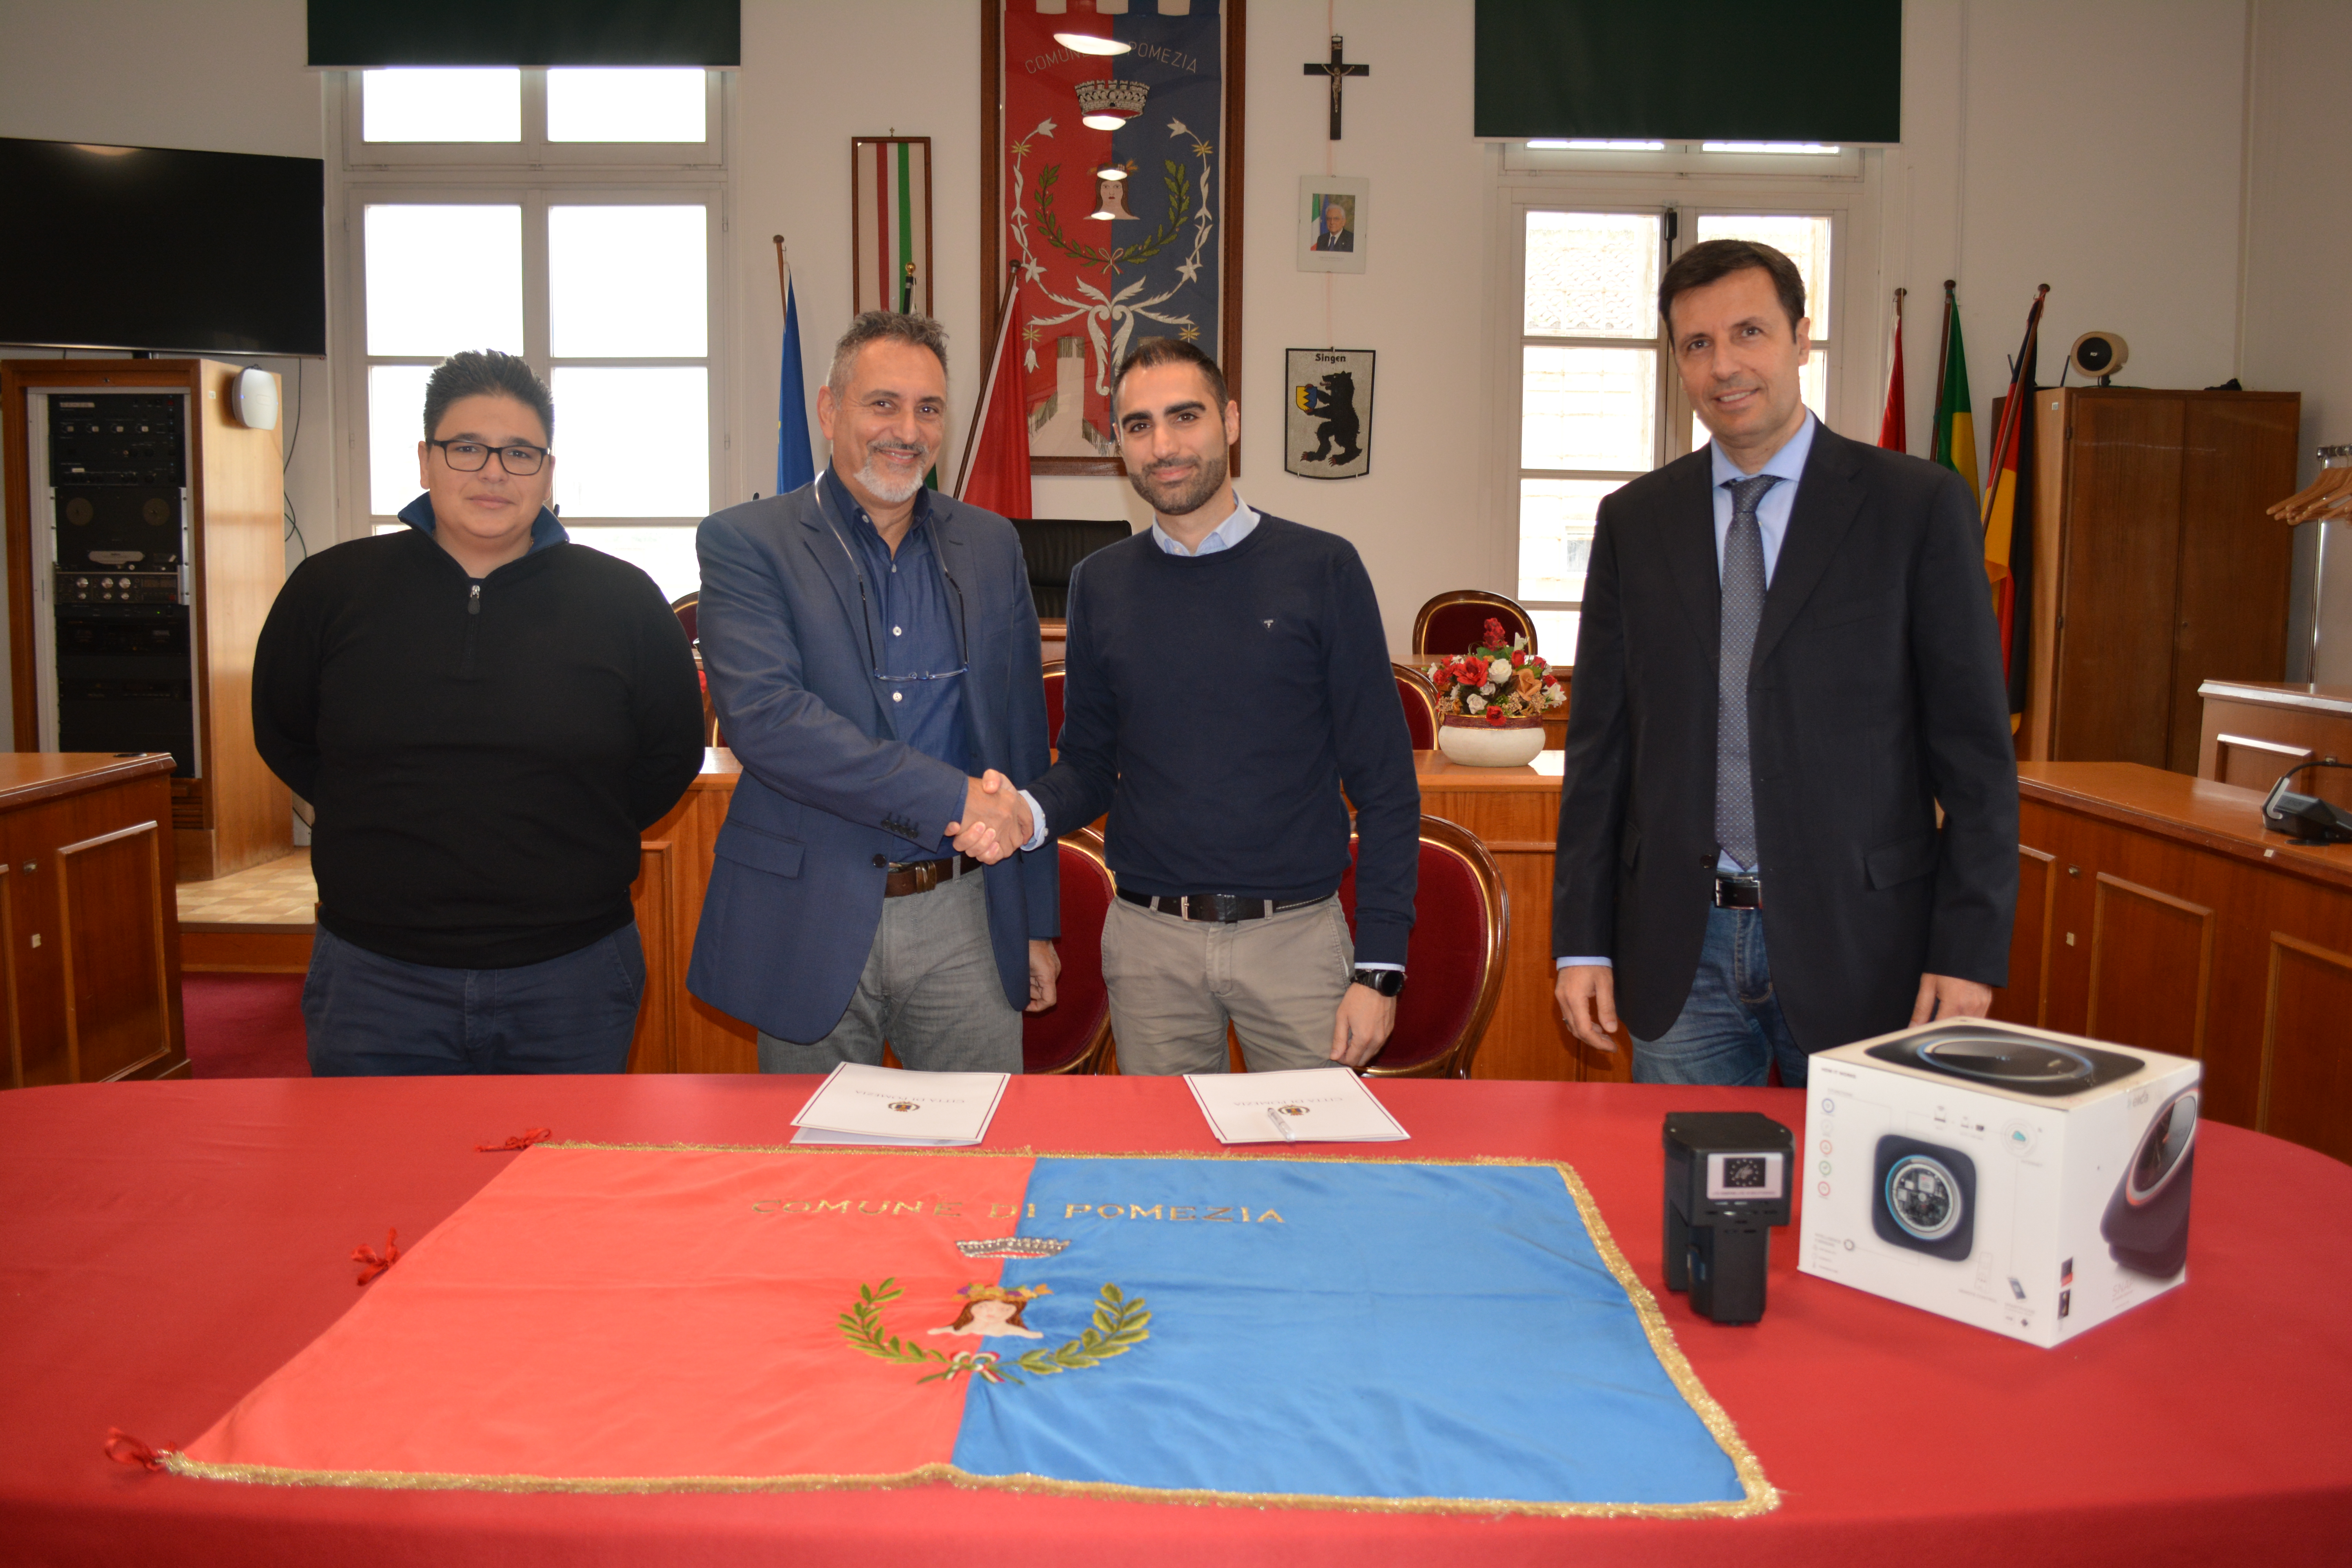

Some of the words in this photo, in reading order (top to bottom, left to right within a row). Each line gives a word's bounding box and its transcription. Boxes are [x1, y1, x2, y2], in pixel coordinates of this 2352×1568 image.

[1025, 47, 1092, 74] COMUN
[1127, 41, 1197, 74] POMEZIA
[1315, 353, 1346, 364] Singen
[751, 1200, 963, 1216] COMUNE
[987, 1203, 1036, 1218] DI
[1065, 1203, 1286, 1223] POMEZIA
